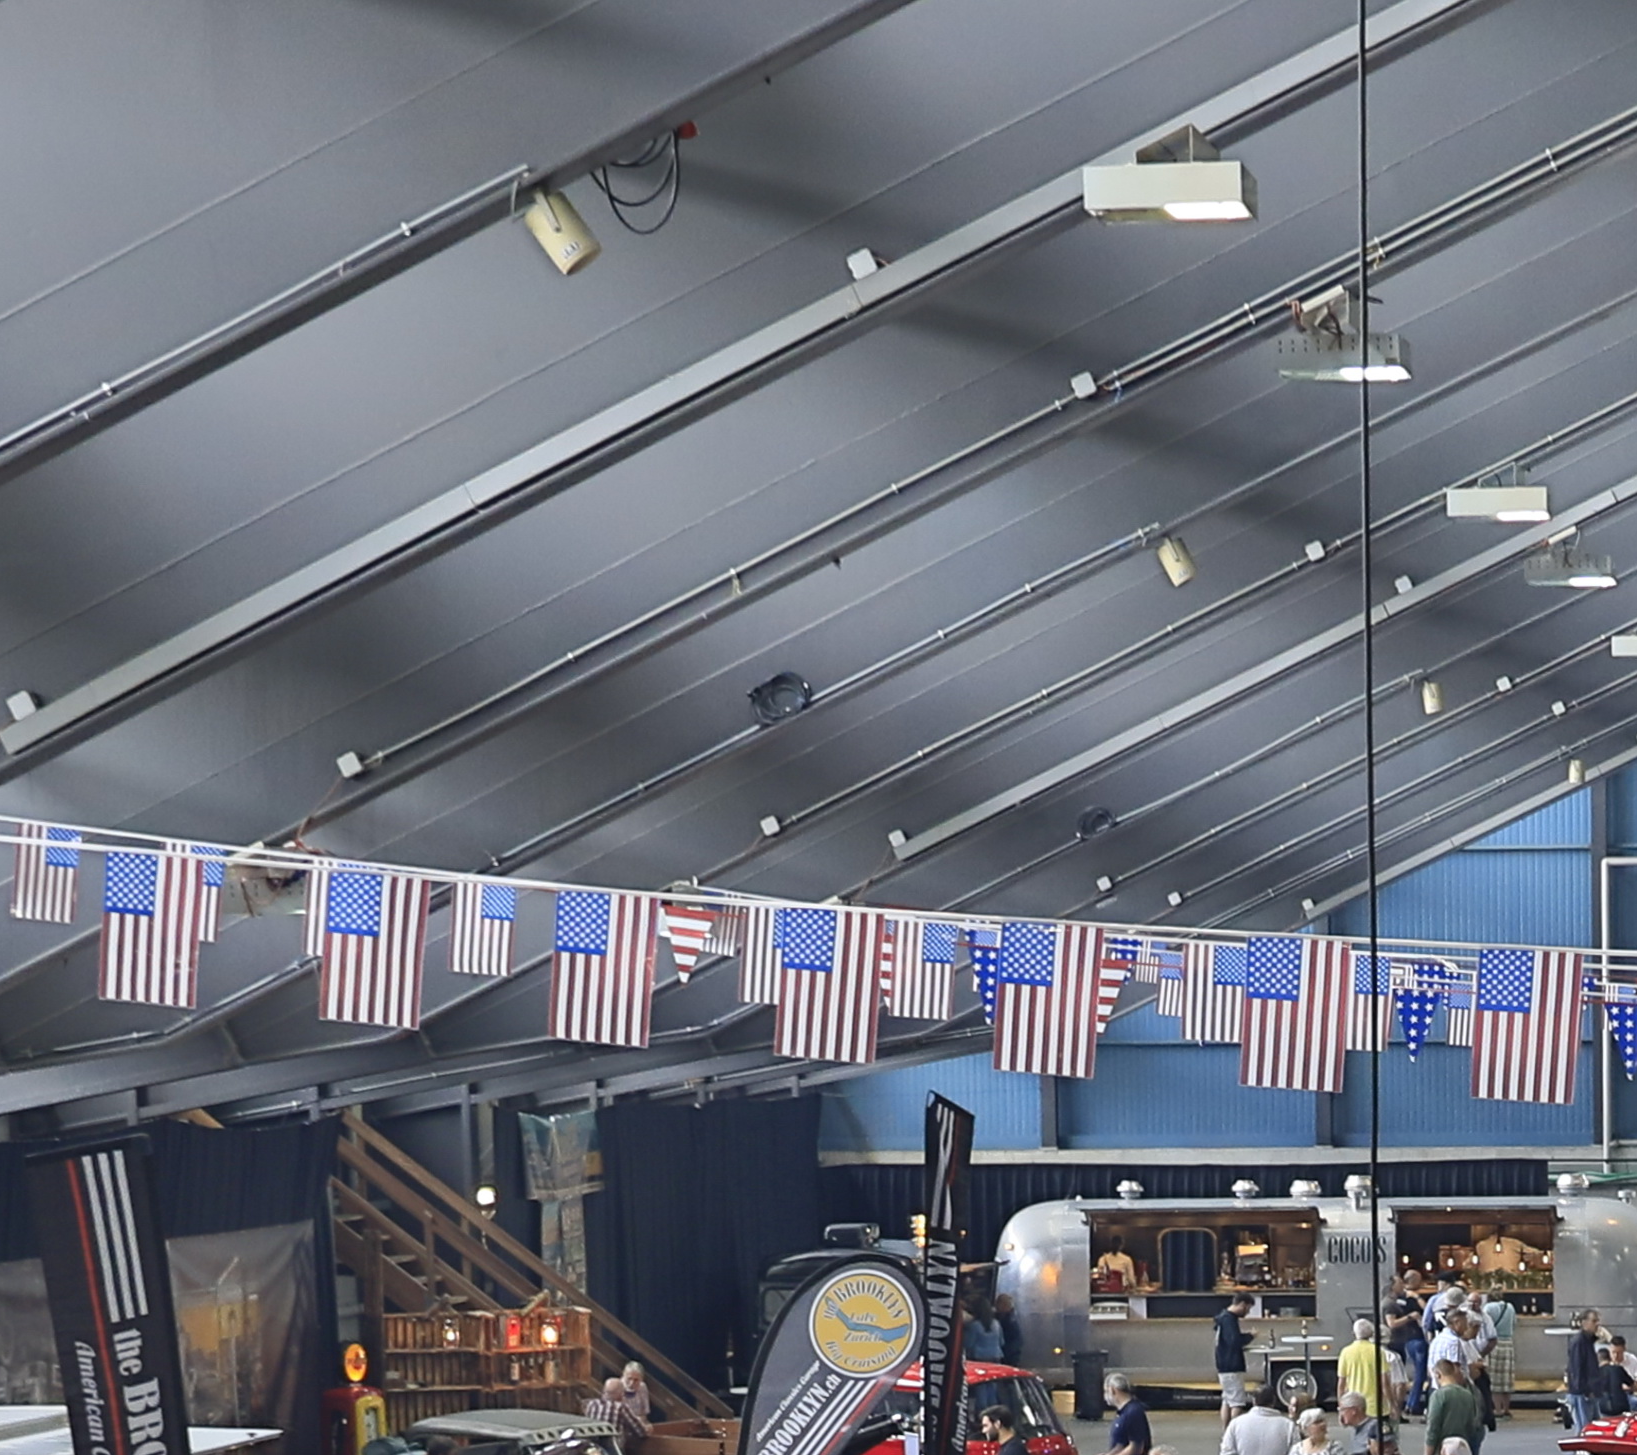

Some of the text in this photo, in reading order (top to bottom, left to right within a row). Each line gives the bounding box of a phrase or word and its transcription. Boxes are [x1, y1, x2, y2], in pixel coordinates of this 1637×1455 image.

[833, 1279, 907, 1320] BROOKLYN
[113, 1326, 143, 1377] the
[74, 1340, 106, 1443] American
